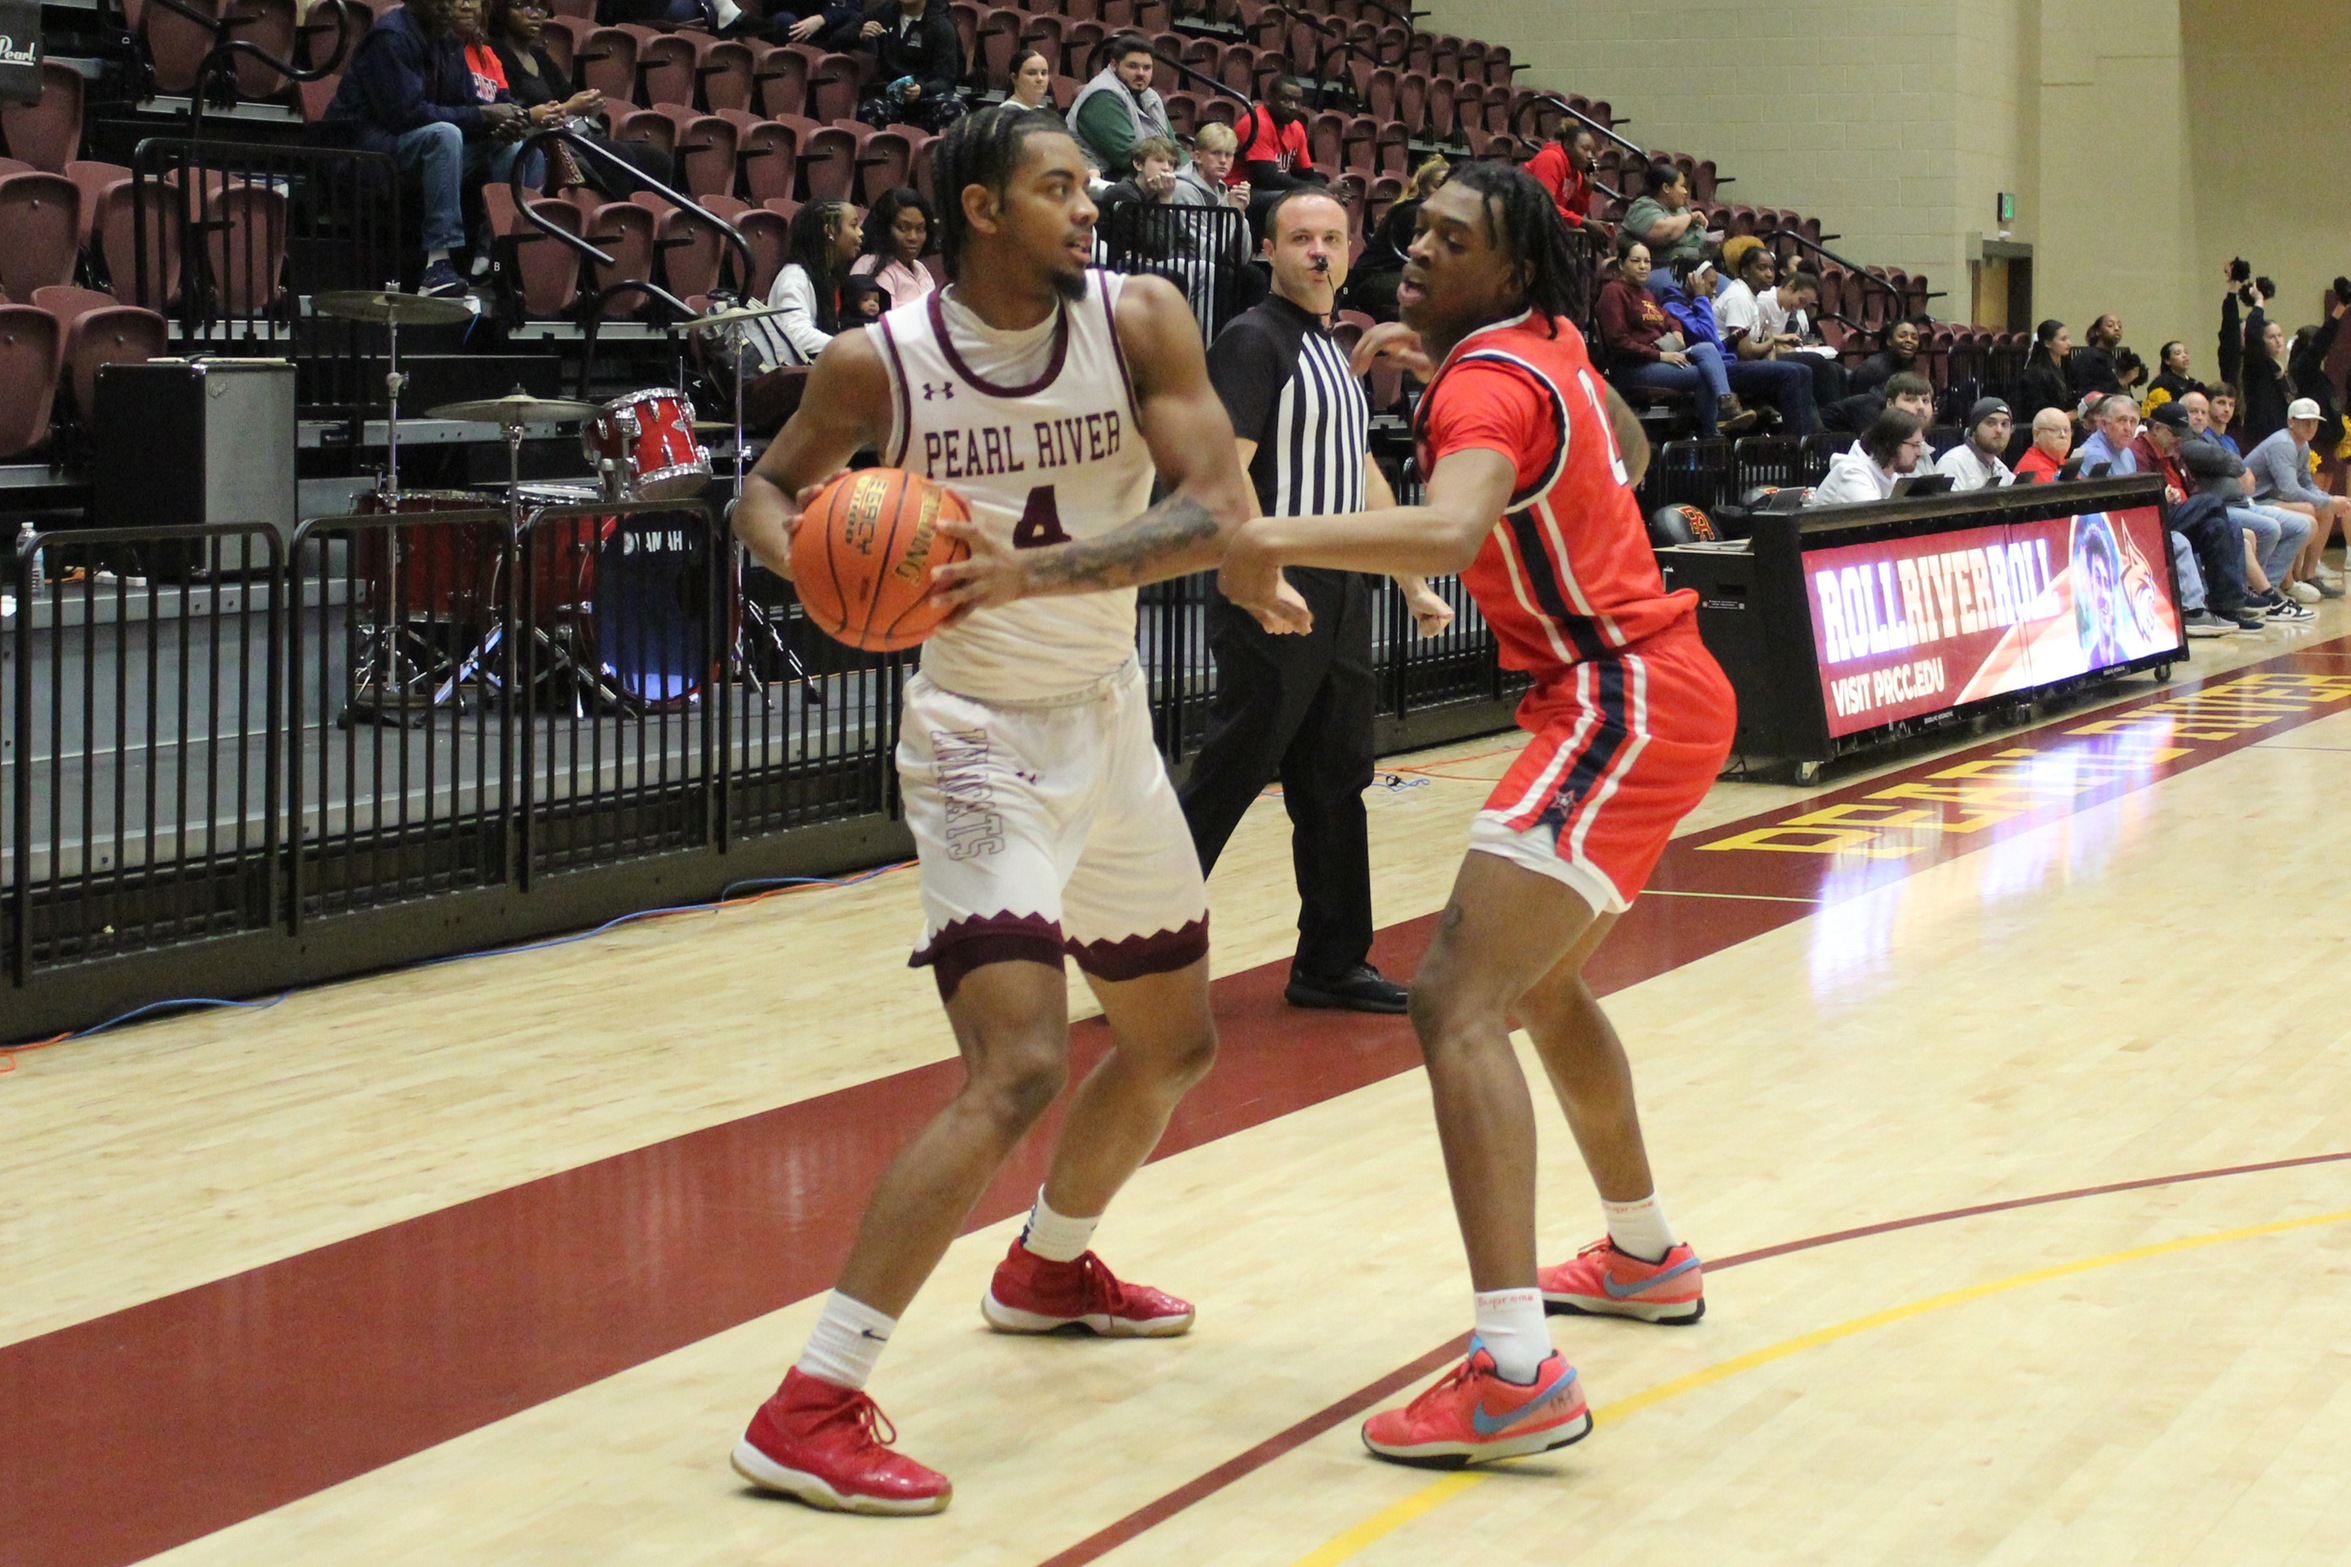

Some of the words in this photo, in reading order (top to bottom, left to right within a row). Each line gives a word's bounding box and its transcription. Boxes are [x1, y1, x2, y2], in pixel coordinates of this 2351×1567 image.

[493, 261, 501, 272] B
[924, 425, 1025, 479] PEARL
[1034, 410, 1121, 468] RIVER
[1013, 484, 1073, 551] 4
[1830, 673, 1872, 717] VISIT
[1872, 656, 1945, 708] PRCC.EDU
[930, 728, 1005, 861] WCATS
